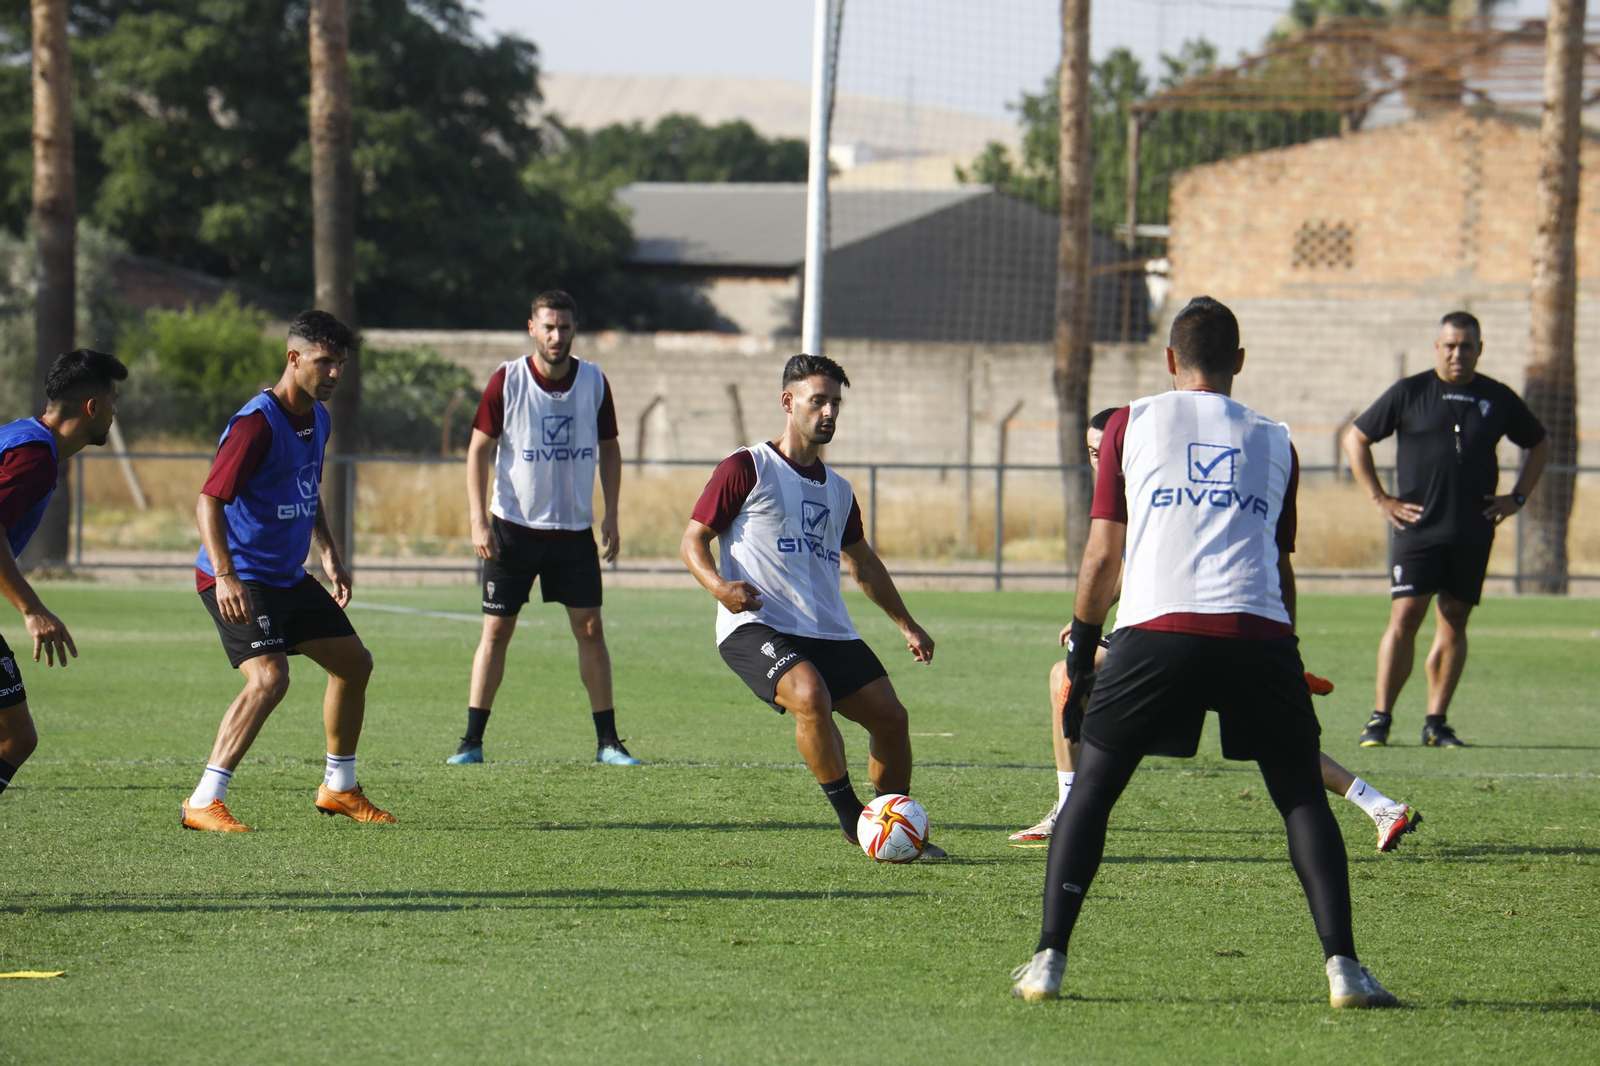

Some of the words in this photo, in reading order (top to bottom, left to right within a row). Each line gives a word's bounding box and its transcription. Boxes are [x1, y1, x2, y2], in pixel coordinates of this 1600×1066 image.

[522, 447, 594, 462] GIVOVA
[277, 500, 318, 520] GIV
[1151, 487, 1269, 520] GIVOVA
[777, 537, 841, 569] GIVOVA
[250, 638, 284, 649] GIVOVA
[766, 651, 798, 679] GIVOVA
[0, 682, 24, 697] GIVO
